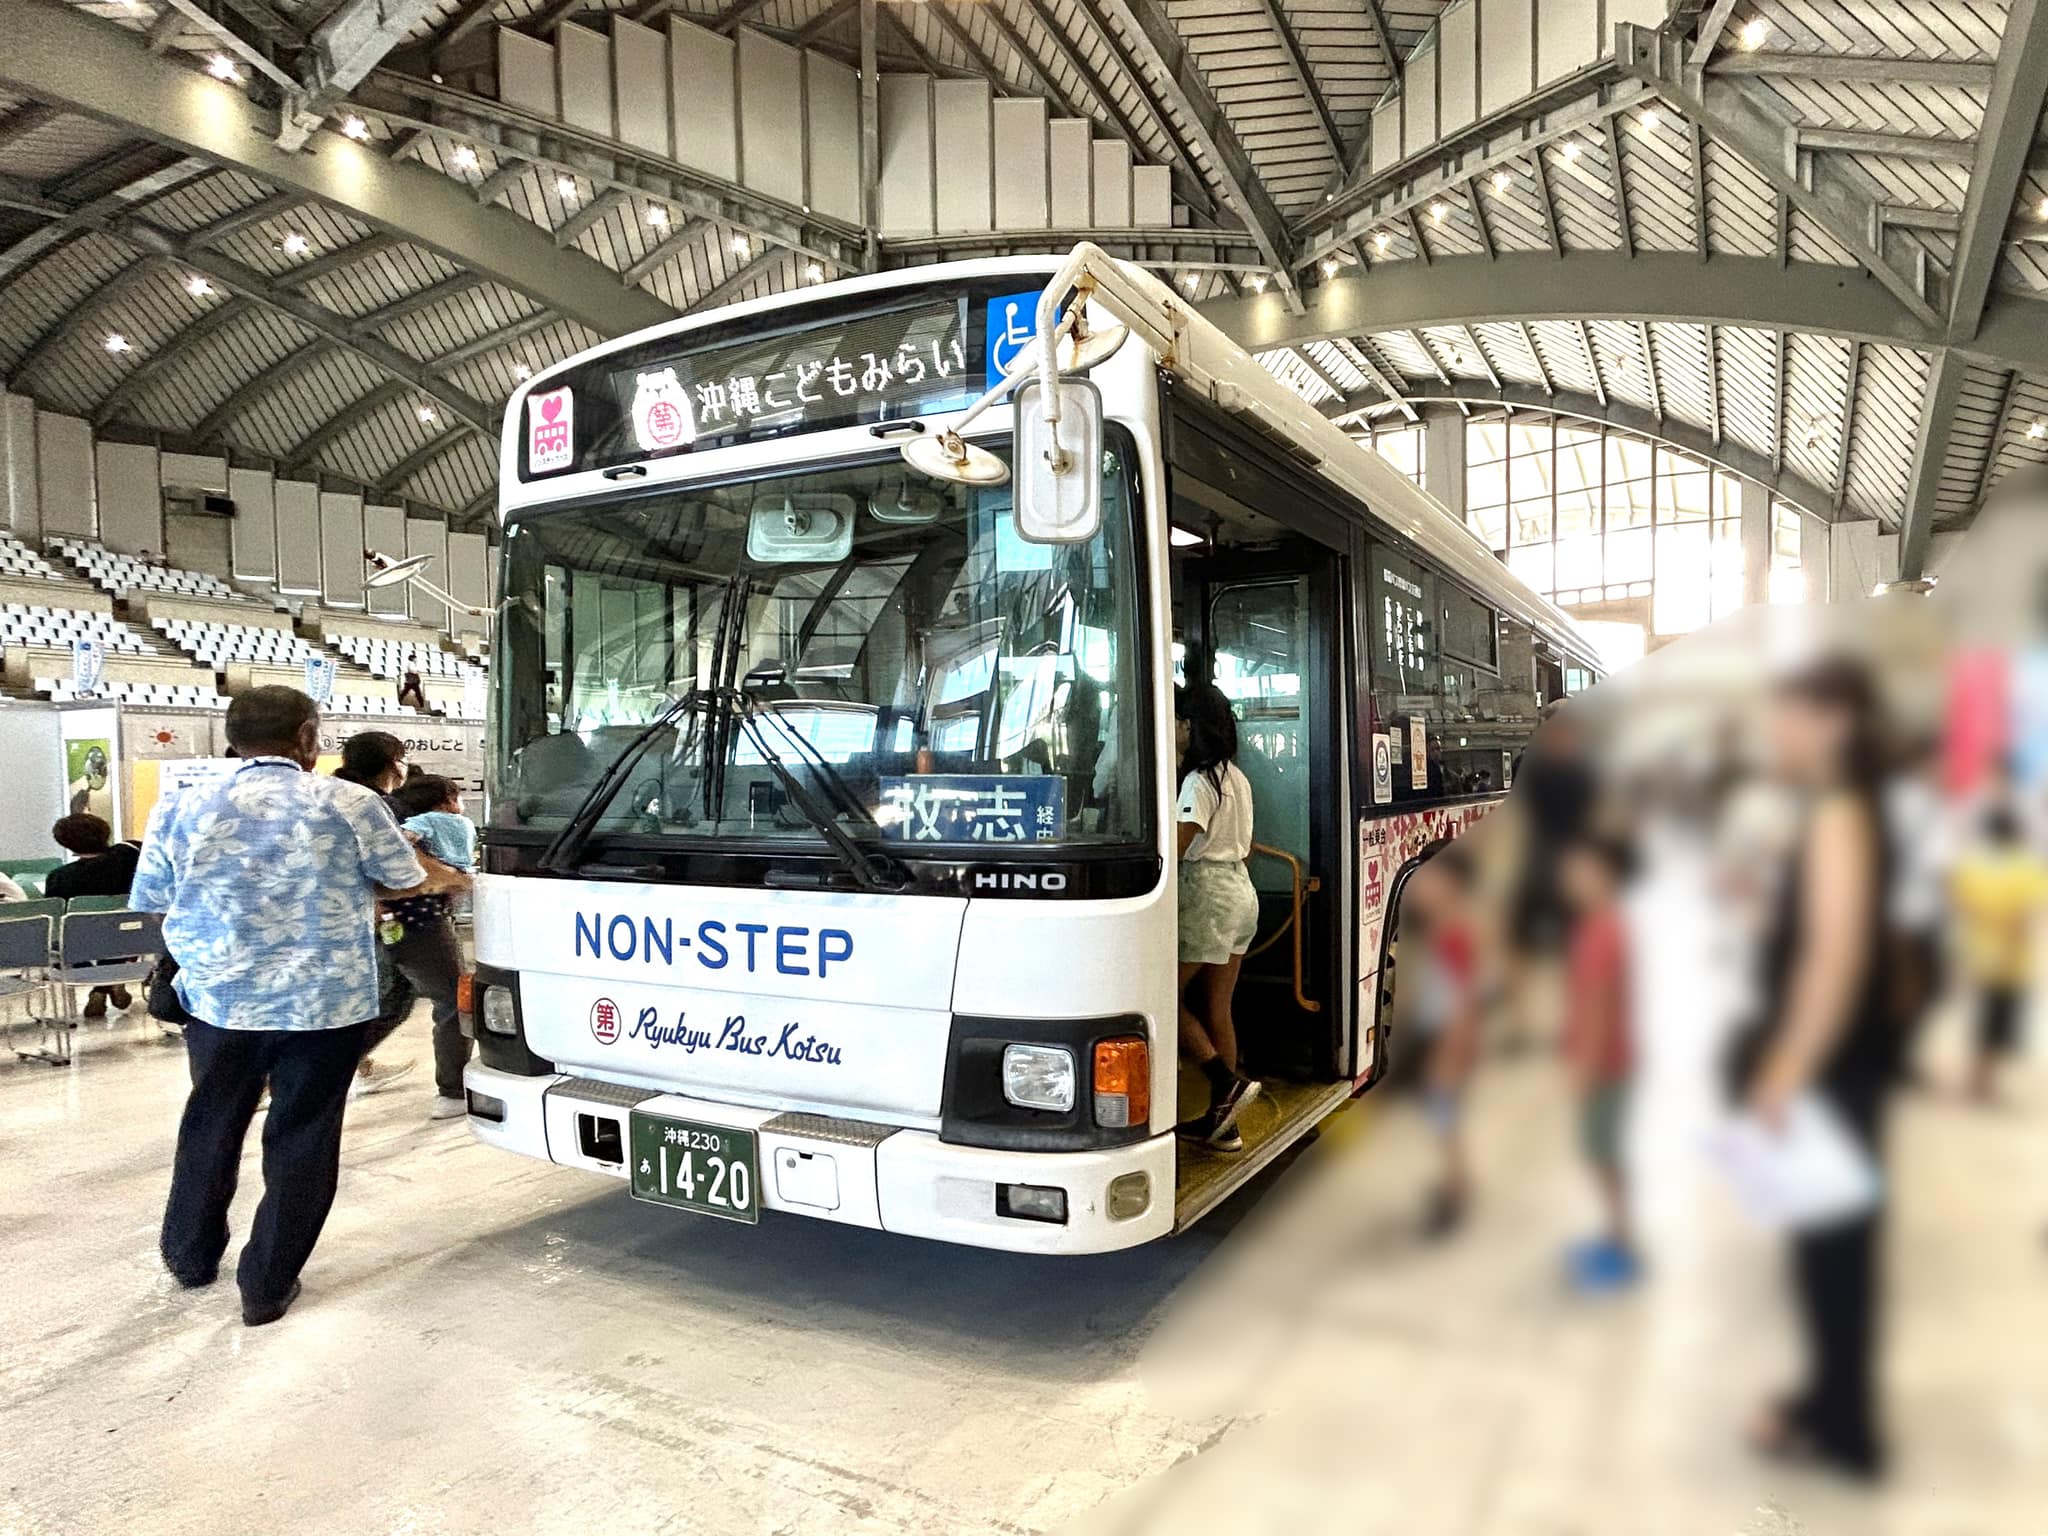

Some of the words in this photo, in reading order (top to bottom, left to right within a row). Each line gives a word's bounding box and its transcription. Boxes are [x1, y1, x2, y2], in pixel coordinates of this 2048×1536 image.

[696, 339, 965, 423] 沖縄こどもみらい
[975, 873, 1067, 890] HINO
[575, 911, 854, 979] NON-STEP
[629, 1006, 712, 1054] Ryukyu
[716, 1015, 767, 1056] Bus
[768, 1022, 842, 1065] Kotsu
[640, 1158, 651, 1175] あ
[659, 1146, 750, 1210] 14-20
